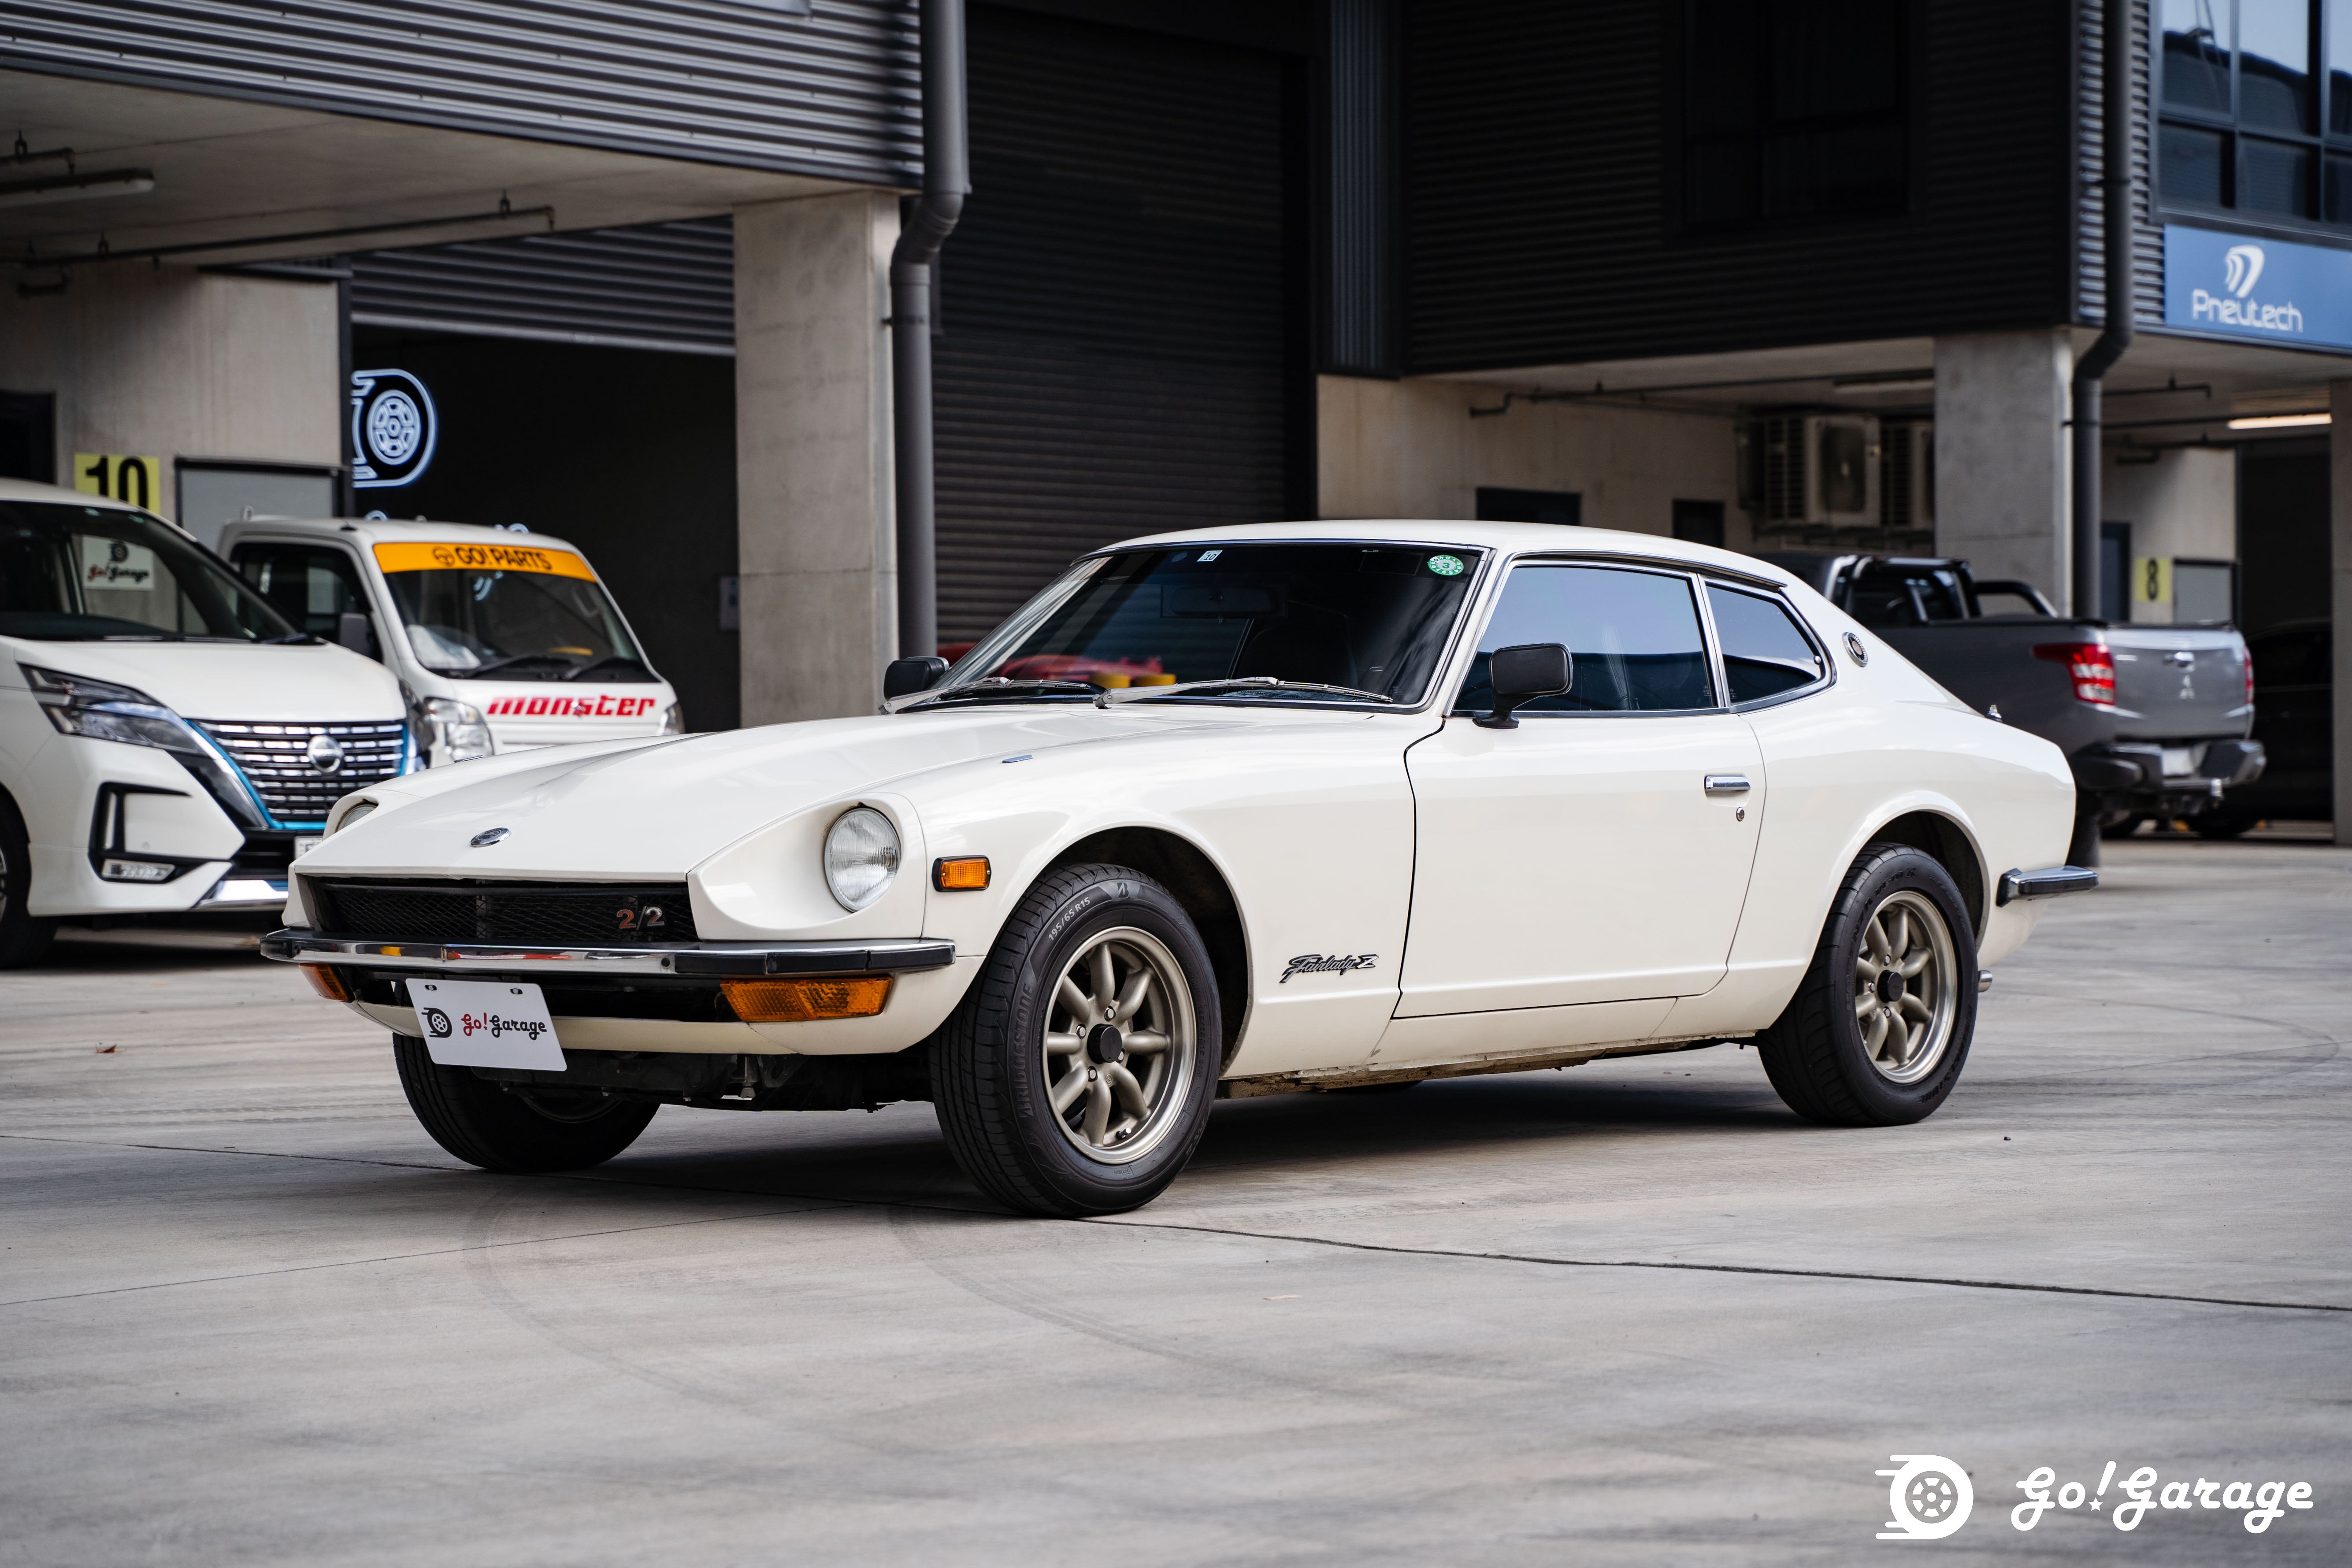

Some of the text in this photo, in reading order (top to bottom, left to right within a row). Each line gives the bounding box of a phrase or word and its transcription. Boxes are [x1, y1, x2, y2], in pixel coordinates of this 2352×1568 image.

[2192, 289, 2303, 333] Pneutech
[86, 455, 148, 509] 10
[490, 549, 552, 570] PARTS
[2146, 557, 2158, 600] 8
[487, 694, 656, 716] monster
[616, 906, 665, 930] 2/2
[1279, 954, 1380, 983] Fairlady Z
[1014, 982, 1035, 1118] BRIDGESTONE
